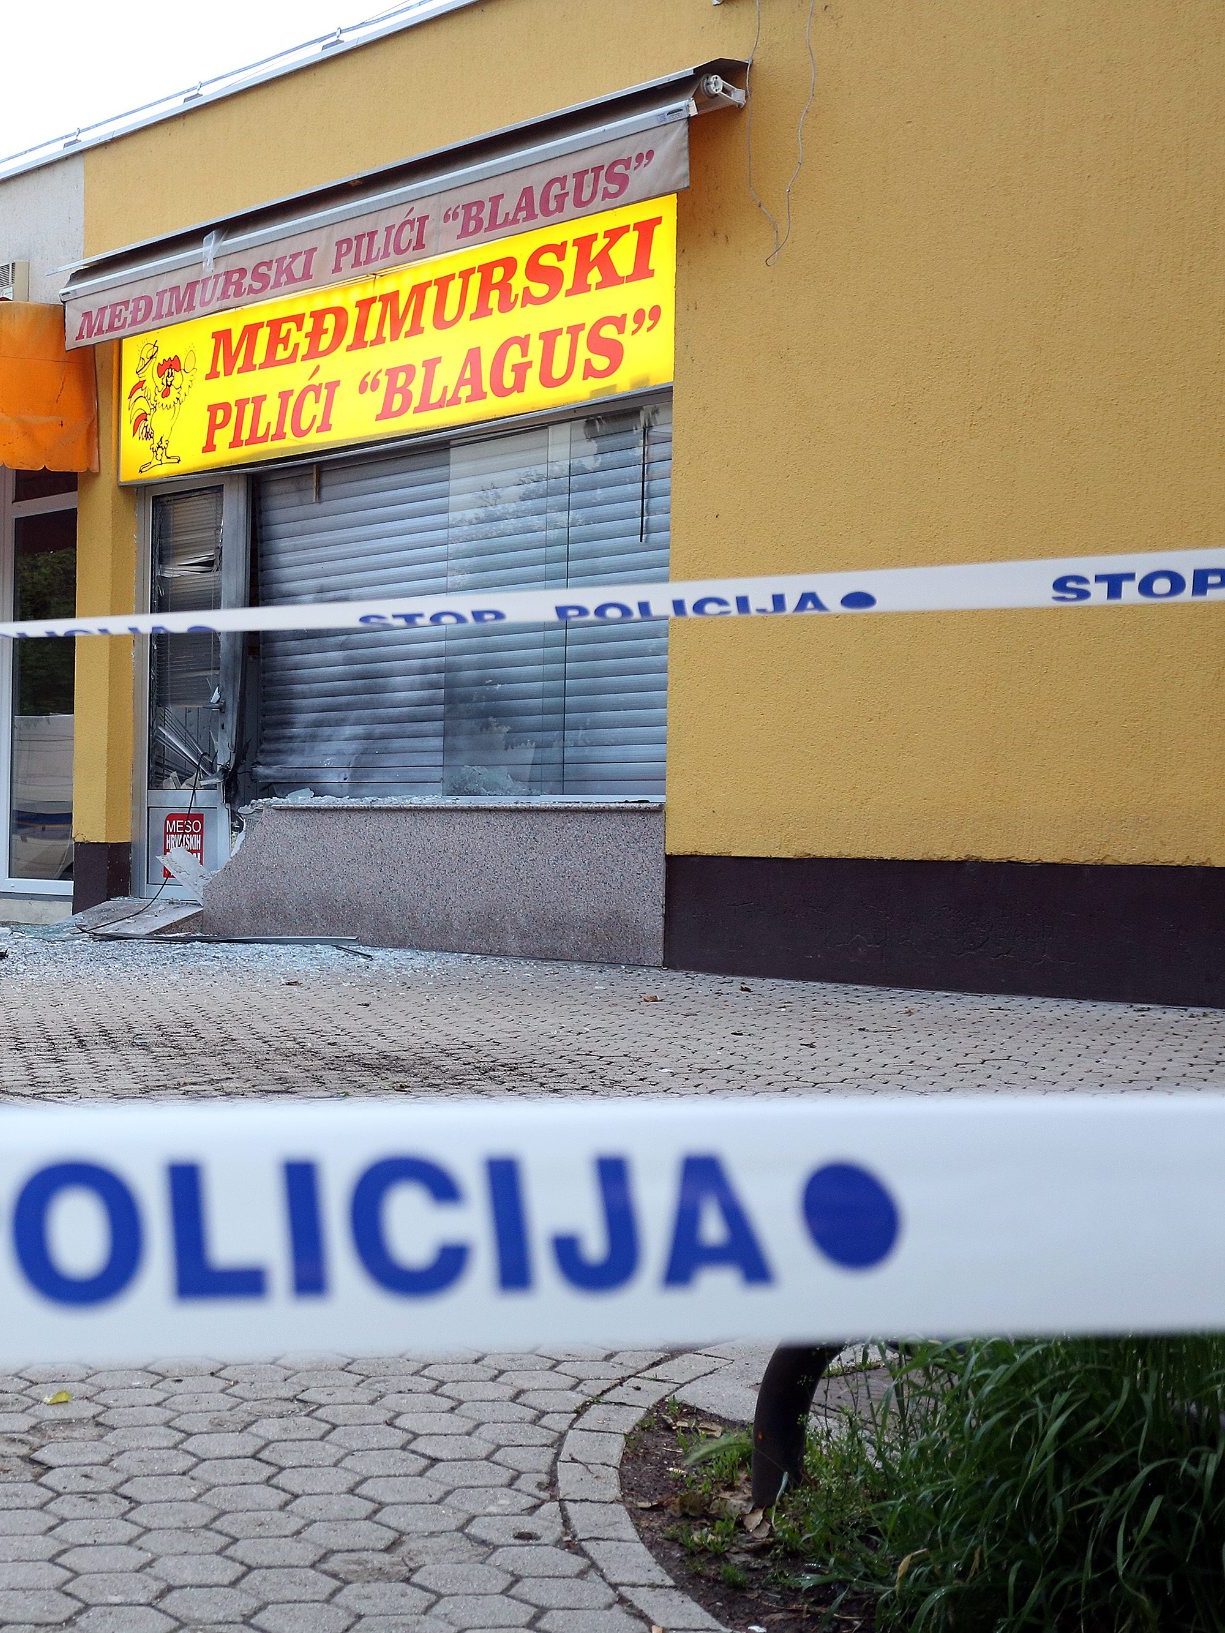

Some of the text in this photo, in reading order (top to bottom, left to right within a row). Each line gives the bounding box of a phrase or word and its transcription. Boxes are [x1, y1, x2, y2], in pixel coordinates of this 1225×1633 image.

[76, 247, 315, 341] MEĐIMURSKI
[331, 210, 429, 274] PILIĆI
[205, 216, 664, 380] MEĐIMURSKI
[201, 366, 340, 453] PILIĆI
[554, 592, 830, 621] POLICIJA
[1051, 568, 1225, 602] STOP
[166, 820, 202, 833] MESO
